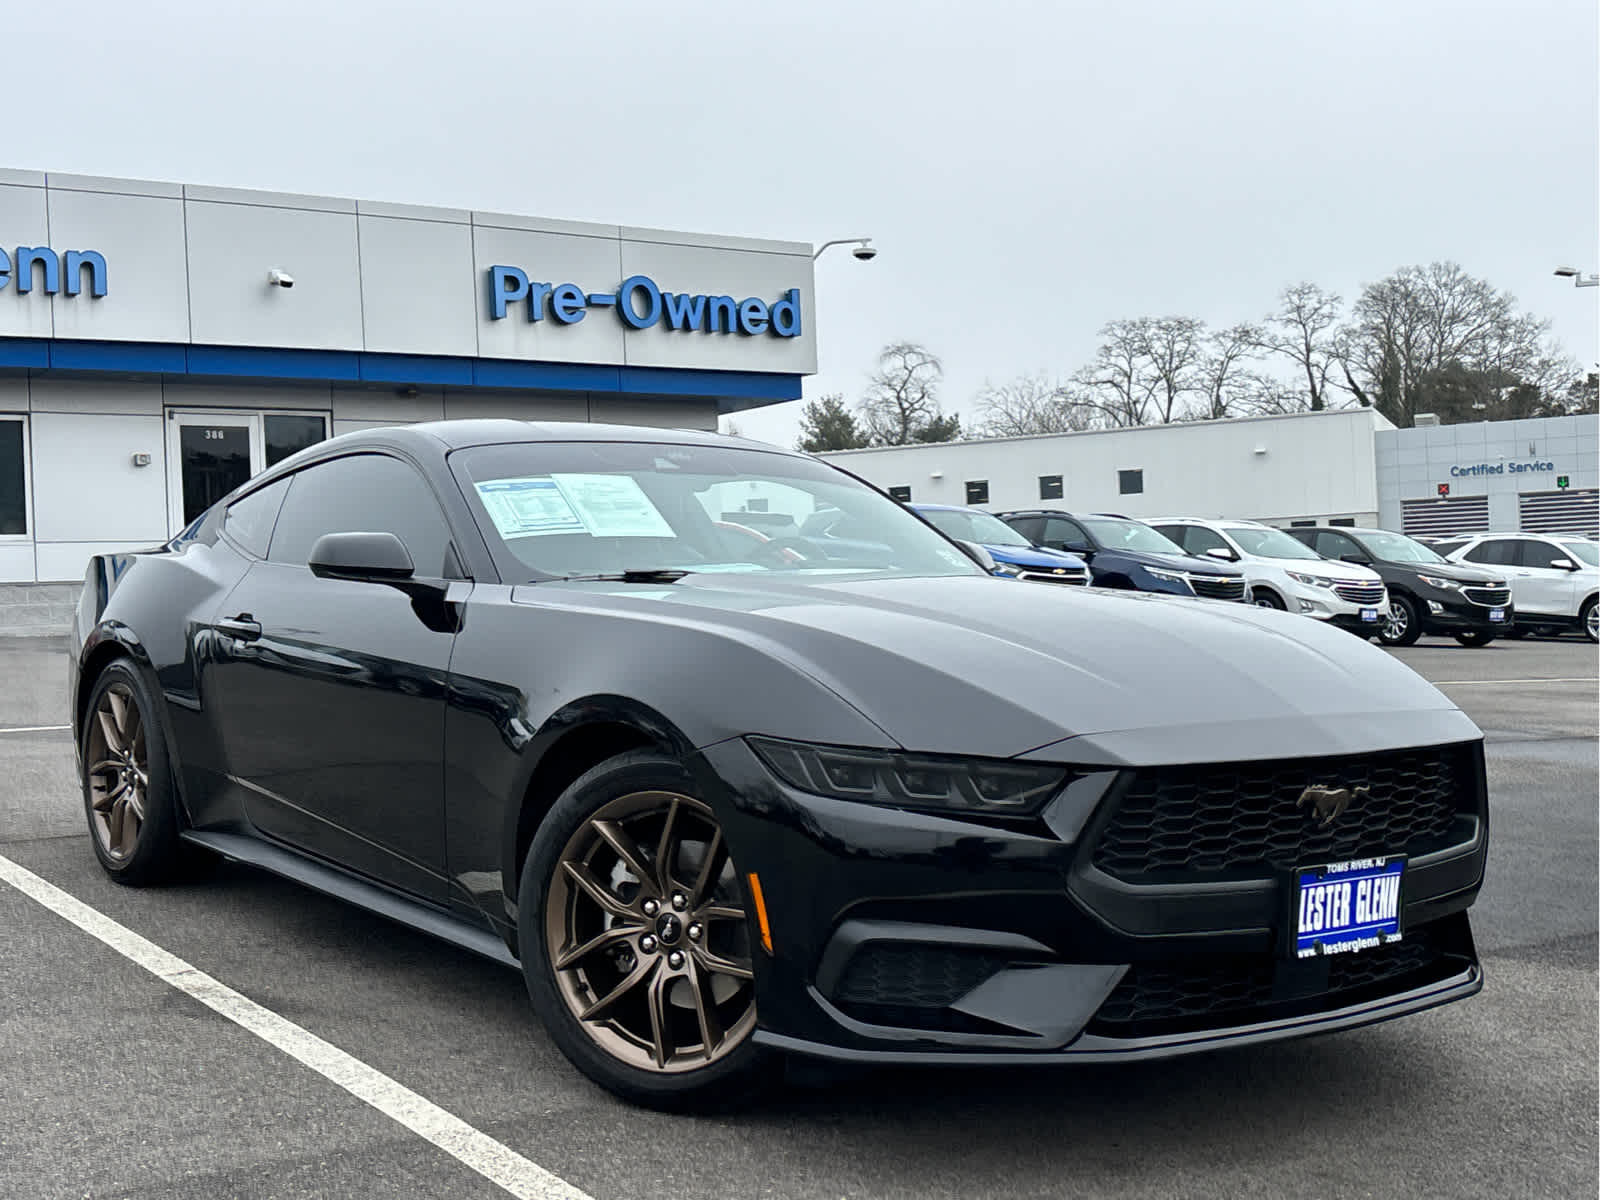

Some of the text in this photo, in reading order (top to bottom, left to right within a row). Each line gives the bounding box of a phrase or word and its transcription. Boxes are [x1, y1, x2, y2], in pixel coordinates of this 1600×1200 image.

[0, 247, 108, 298] nn
[488, 264, 802, 338] Pre-Owned
[1450, 460, 1554, 477] Certified Service
[1326, 862, 1349, 874] TOMS
[1375, 857, 1386, 867] NJ
[1298, 875, 1400, 933] LESTER GLENN
